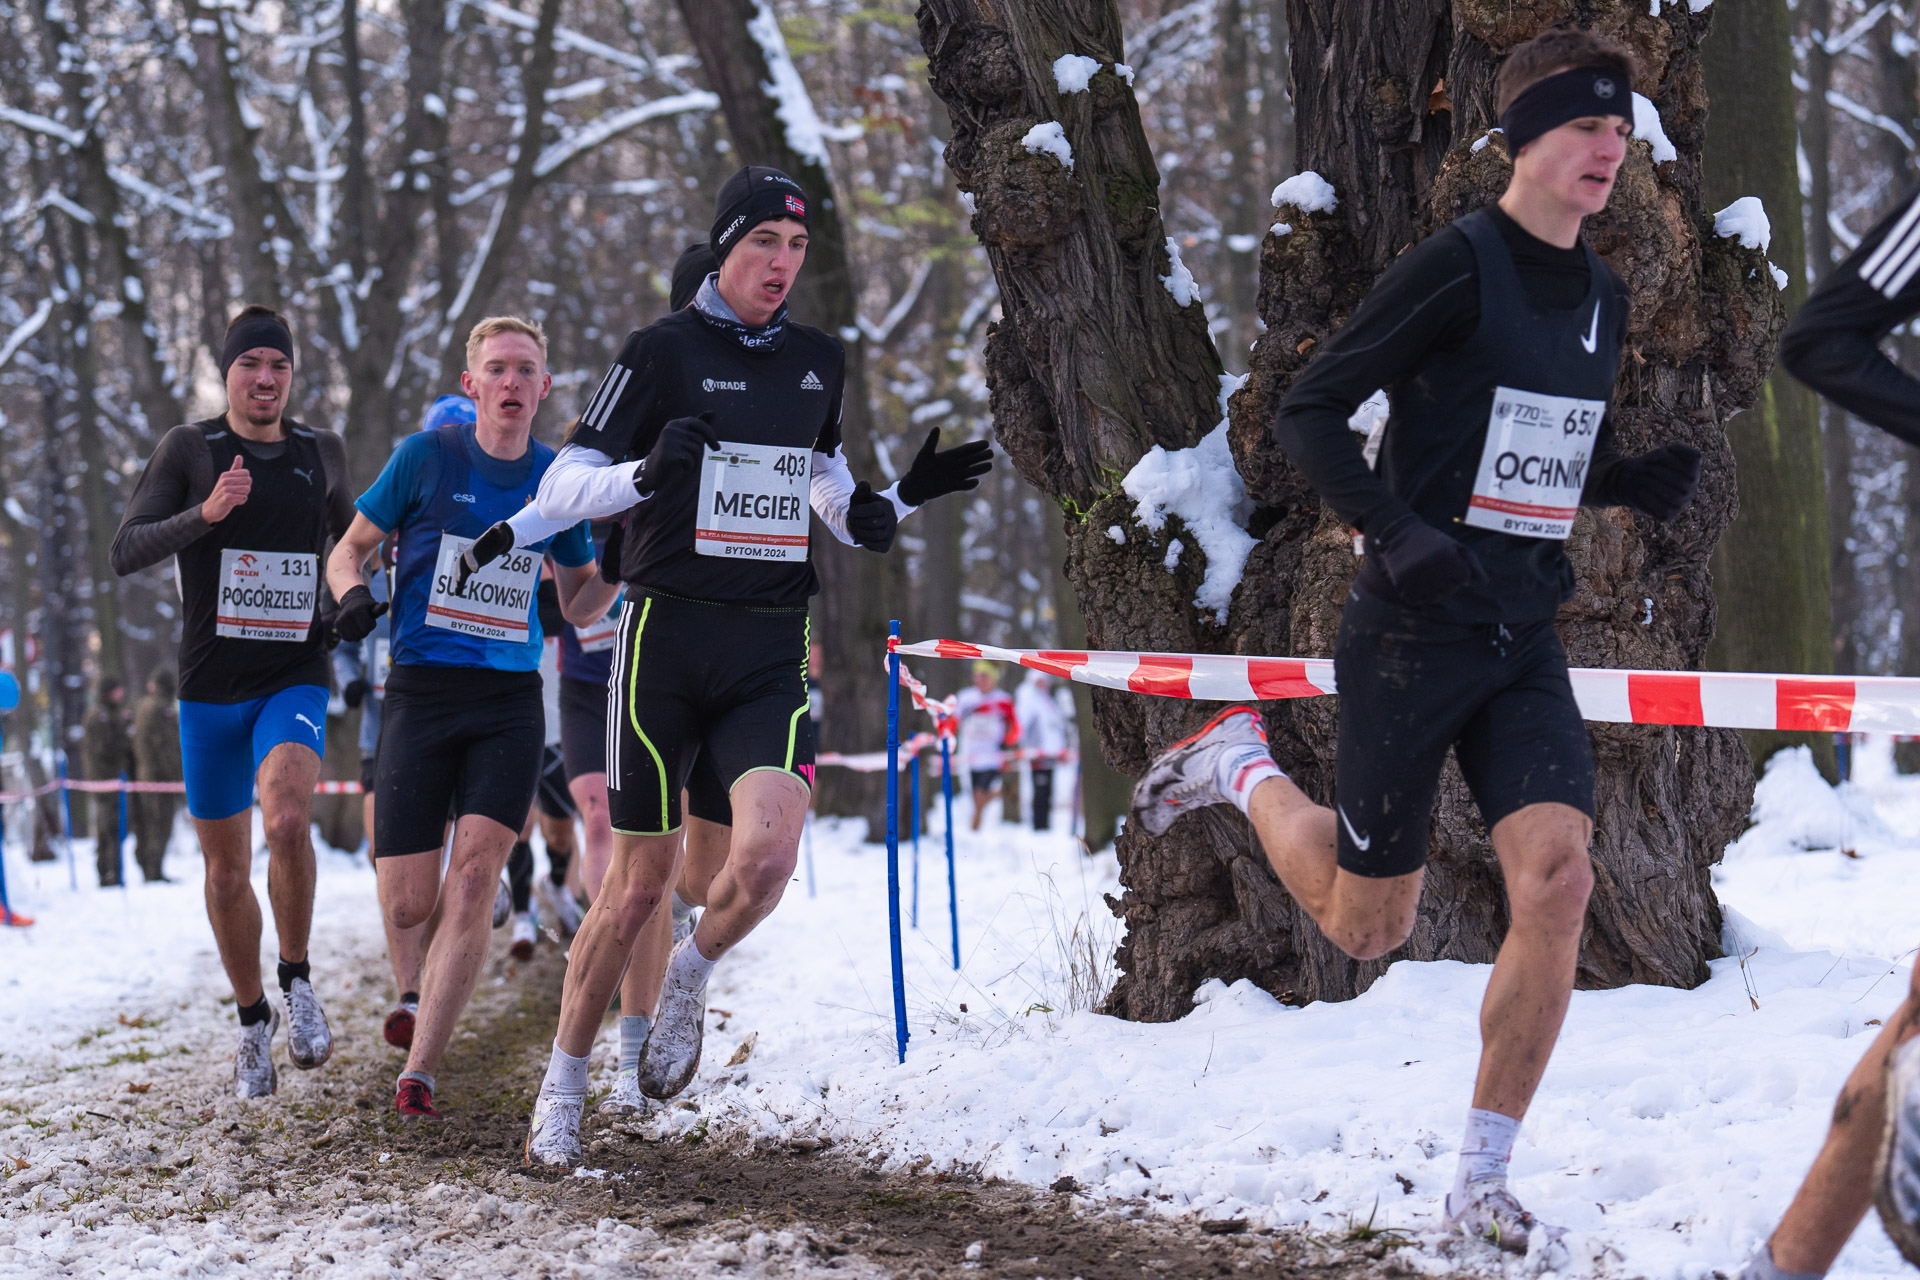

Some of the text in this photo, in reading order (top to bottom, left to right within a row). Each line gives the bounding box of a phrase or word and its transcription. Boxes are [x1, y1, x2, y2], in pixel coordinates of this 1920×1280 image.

[719, 218, 739, 244] CRAFT
[800, 383, 824, 391] adidas
[1515, 403, 1540, 420] 770
[1563, 409, 1597, 435] 650
[773, 453, 806, 477] 403
[1495, 451, 1587, 489] OCHNIK
[453, 493, 476, 503] esa
[714, 491, 801, 521] MEGIER
[1504, 519, 1566, 535] BYTOM 2024
[724, 546, 786, 558] BYTOM 2024
[281, 558, 311, 577] 131
[499, 552, 533, 574] 268
[234, 569, 260, 577] ORLEN
[222, 586, 313, 610] POGORZELSKI
[240, 628, 297, 639] BYTOM 2024
[450, 621, 506, 638] BYTOM 2024
